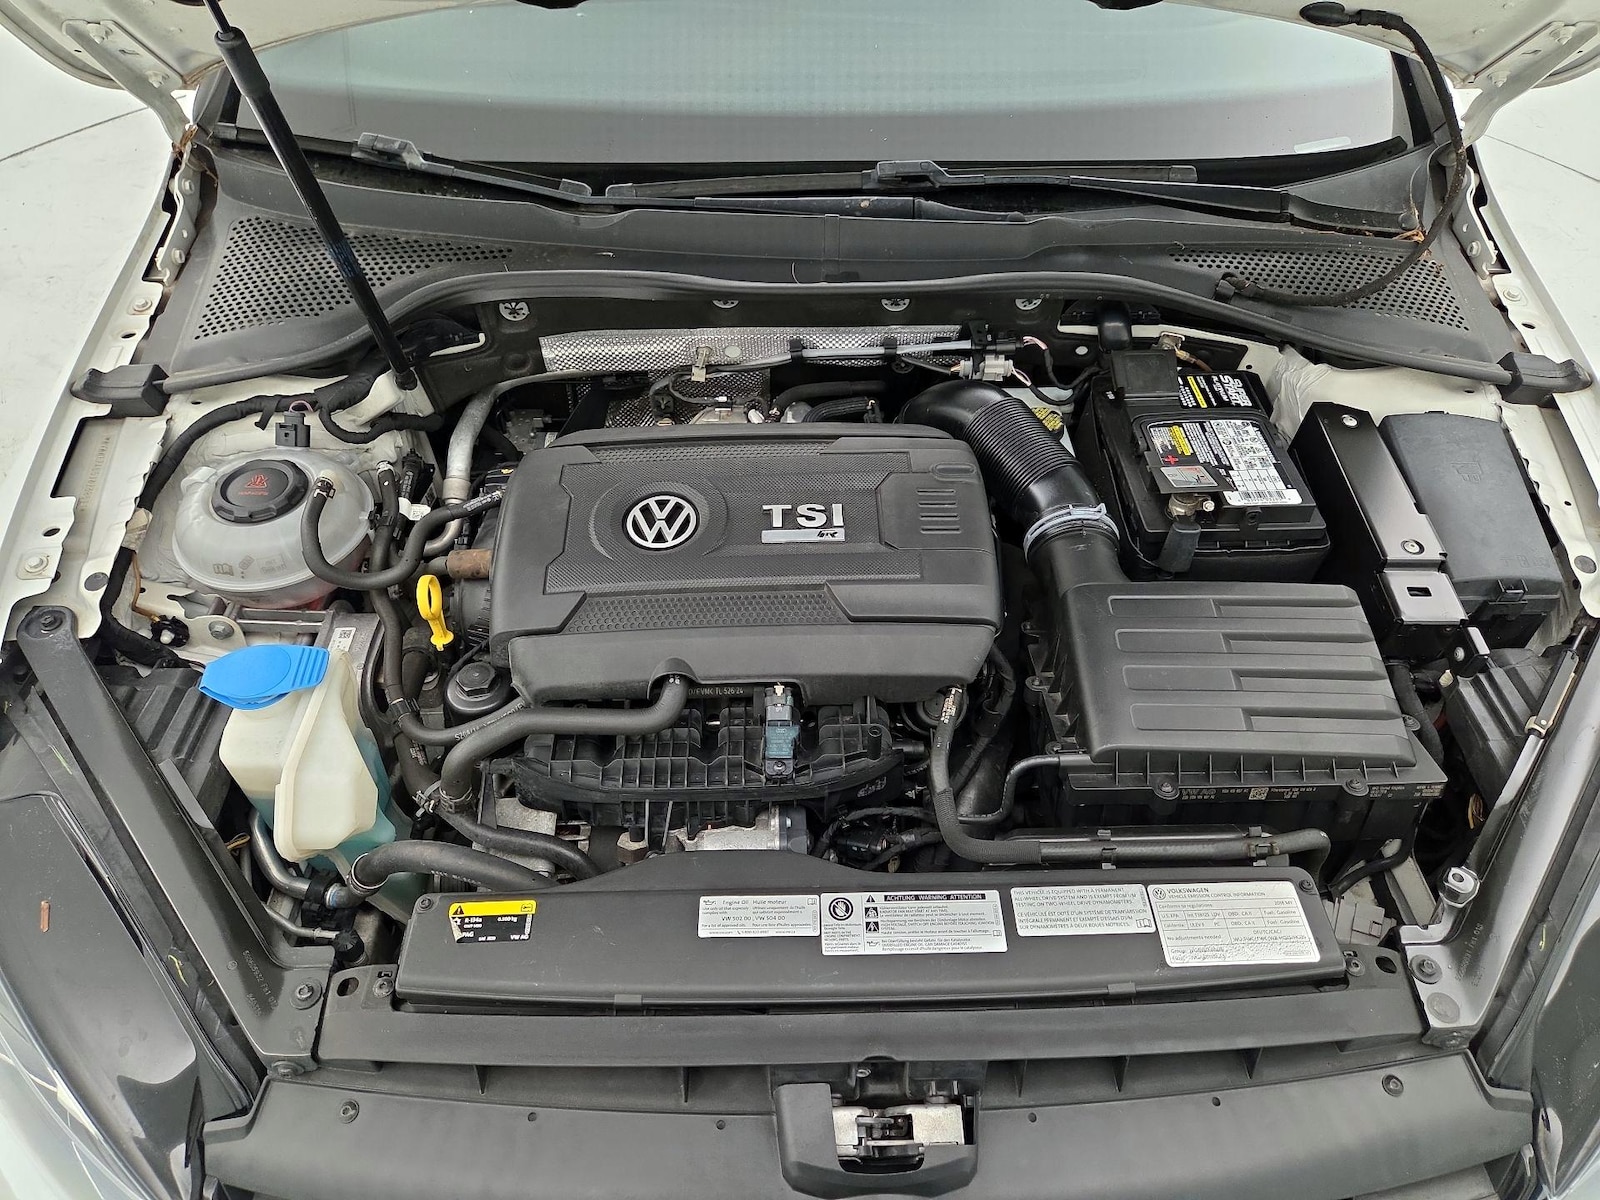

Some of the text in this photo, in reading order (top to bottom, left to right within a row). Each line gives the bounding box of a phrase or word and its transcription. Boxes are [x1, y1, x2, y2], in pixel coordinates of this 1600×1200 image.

[1220, 375, 1240, 406] START
[1233, 379, 1252, 407] SUPER
[762, 503, 844, 528] TSI
